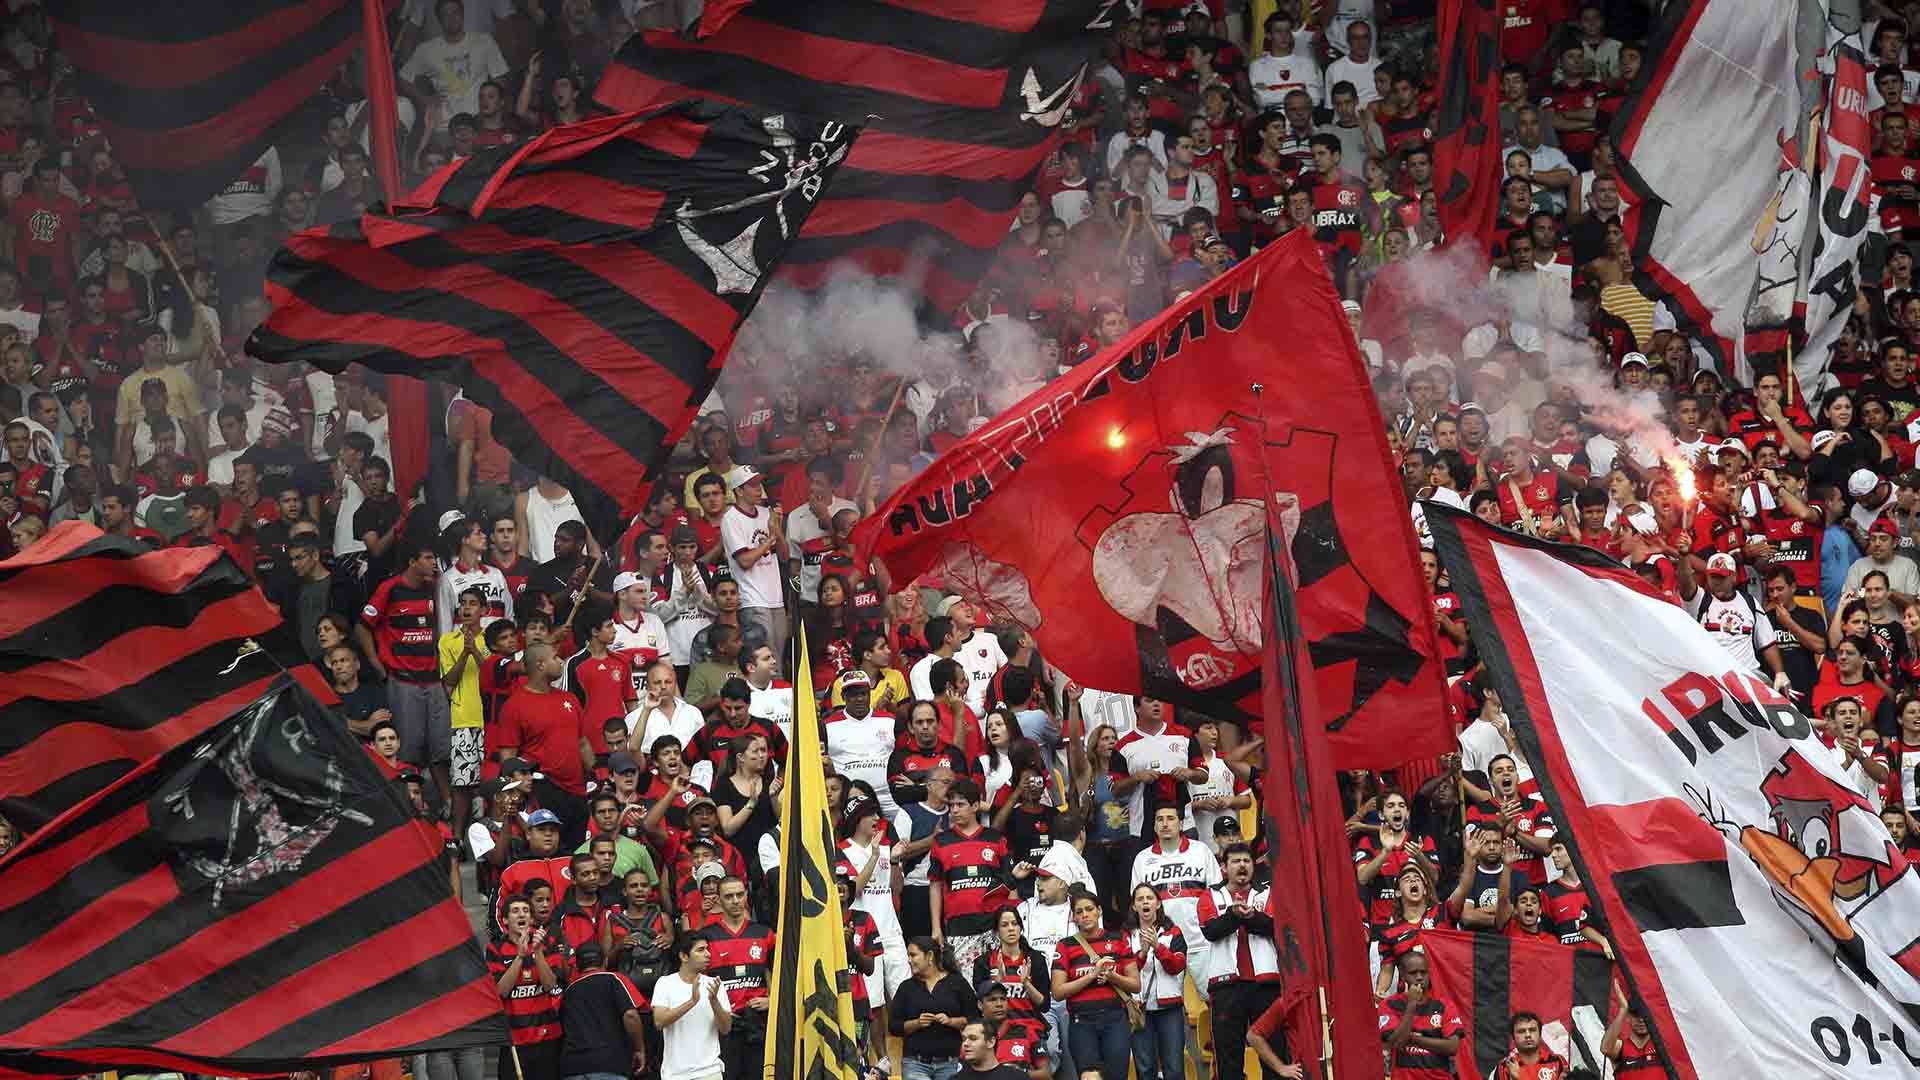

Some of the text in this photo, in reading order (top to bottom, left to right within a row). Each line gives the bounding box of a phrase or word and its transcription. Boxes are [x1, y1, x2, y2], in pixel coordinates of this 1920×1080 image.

[1312, 211, 1356, 226] UBRAX
[1144, 863, 1204, 884] LUBRAX
[1561, 935, 1585, 945] PETRO
